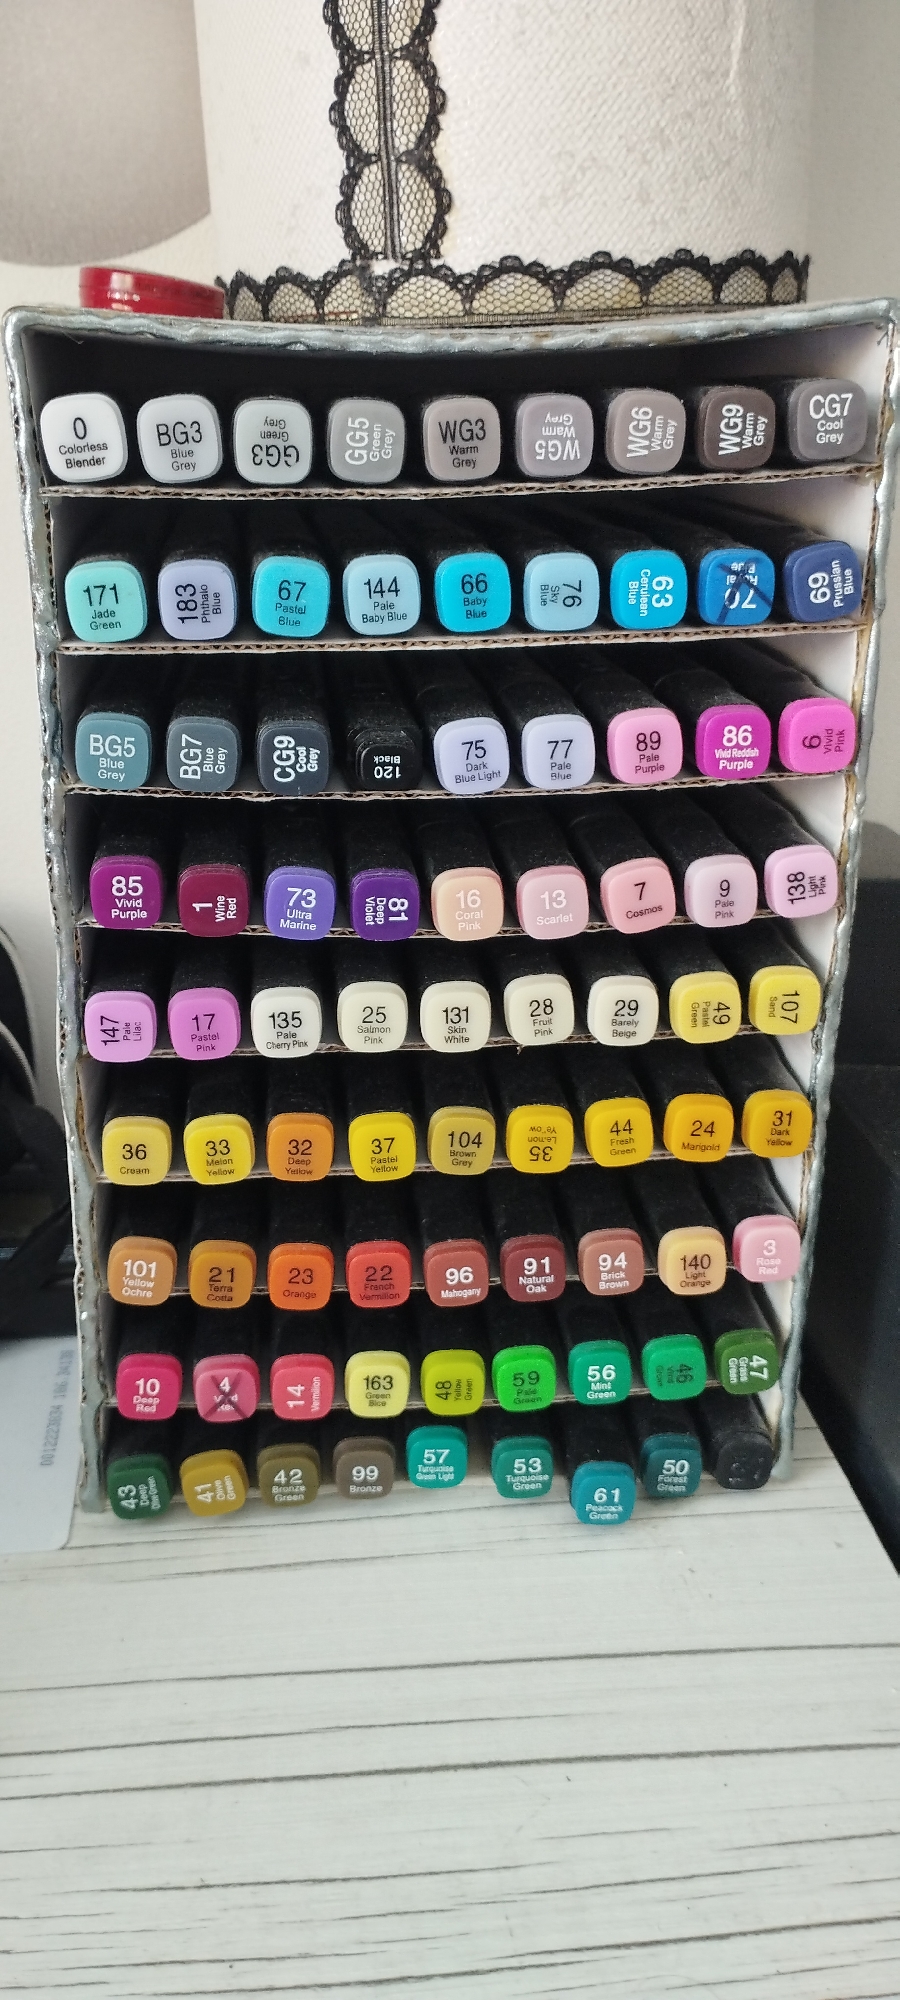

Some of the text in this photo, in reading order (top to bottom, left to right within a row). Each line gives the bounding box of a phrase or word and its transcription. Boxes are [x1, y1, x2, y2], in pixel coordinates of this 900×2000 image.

[809, 393, 853, 419] CG7
[264, 416, 286, 428] Grey
[545, 413, 573, 425] Grey
[817, 419, 843, 430] Cool
[73, 417, 87, 440] 0
[156, 421, 202, 446] BG3
[260, 432, 289, 441] Green
[438, 419, 486, 443] WG3
[542, 427, 576, 437] Warm
[627, 406, 652, 457] WG6
[651, 415, 664, 451] Warm
[663, 419, 677, 449] Grey
[718, 404, 744, 455] WG9
[345, 417, 369, 465] GG5
[370, 424, 381, 461] Green
[382, 429, 395, 458] Grey
[816, 432, 844, 444] Grey
[59, 442, 108, 455] Colorless
[171, 449, 194, 458] Blue
[252, 445, 300, 467] GG3
[449, 445, 478, 455] Warm
[535, 440, 580, 461] WG5
[65, 457, 106, 468] Blender
[172, 461, 196, 472] Grey
[452, 458, 476, 468] Grey
[364, 576, 400, 599] 144
[461, 573, 487, 595] 66
[808, 572, 831, 604] 69
[833, 560, 844, 608] Prussian
[844, 568, 852, 595] Blue
[82, 583, 119, 607] 171
[278, 579, 306, 602] 67
[563, 580, 582, 607] 76
[628, 581, 639, 605] Blue
[639, 569, 650, 617] Cerulean
[652, 576, 674, 608] 63
[175, 583, 199, 624] 183
[202, 584, 211, 623] Phthalo
[212, 592, 221, 615] Blue
[373, 601, 394, 611] Pale
[463, 597, 487, 607] Baby
[91, 609, 116, 619] Jade
[362, 611, 407, 624] Baby Blue
[465, 609, 487, 619] Blue
[90, 620, 121, 630] Green
[636, 731, 661, 751] 89
[722, 725, 752, 747] 86
[802, 734, 822, 750] 6
[89, 734, 135, 757] BG5
[462, 739, 486, 760] 75
[547, 739, 573, 759] 77
[714, 747, 759, 759] Vivid Reddish
[99, 758, 124, 769] Blue
[180, 733, 202, 780] BG7
[203, 748, 214, 772] Blue
[215, 747, 228, 774] Grey
[274, 735, 295, 782] CG9
[374, 755, 400, 764] Black
[374, 765, 401, 779] 120
[466, 761, 488, 772] Dark
[719, 760, 753, 771] Purple
[98, 770, 125, 782] Grey
[455, 770, 501, 784] Blue Light
[111, 876, 143, 896] 85
[634, 882, 646, 901] 7
[719, 879, 730, 897] 9
[787, 871, 805, 905] 138
[115, 898, 142, 908] Vivid
[287, 887, 316, 908] 73
[456, 890, 481, 909] 16
[541, 890, 567, 910] 13
[111, 909, 147, 920] Purple
[193, 902, 212, 912] 1
[215, 895, 226, 922] Wine
[226, 897, 236, 919] Red
[286, 909, 311, 920] Ultra
[365, 896, 375, 925] Violet
[376, 897, 386, 925] Deep
[388, 897, 408, 921] 81
[626, 904, 663, 919] Cosmos
[279, 918, 317, 931] Marine
[536, 913, 573, 925] Scarlet
[362, 1006, 386, 1023] 25
[442, 1006, 469, 1024] 131
[529, 998, 554, 1017] 28
[614, 999, 638, 1017] 29
[713, 1002, 731, 1025] 49
[781, 990, 800, 1024] 107
[192, 1013, 216, 1032] 17
[268, 1010, 302, 1030] 135
[101, 1015, 120, 1045] 147
[276, 1031, 297, 1040] Pale
[447, 1026, 466, 1034] Skin
[266, 1039, 308, 1051] Cherry Pink
[444, 1035, 470, 1044] White
[772, 1110, 792, 1127] 31
[609, 1119, 633, 1136] 44
[690, 1120, 715, 1137] 24
[206, 1139, 230, 1157] 33
[288, 1139, 312, 1156] 32
[371, 1137, 395, 1154] 37
[448, 1131, 482, 1149] 104
[122, 1144, 147, 1160] 36
[371, 1155, 397, 1165] Pastel
[450, 1150, 476, 1158] Brown
[529, 1145, 552, 1162] 35
[371, 1164, 398, 1173] Yellow
[452, 1159, 472, 1168] Grey
[763, 1239, 775, 1256] 3
[124, 1259, 157, 1278] 101
[524, 1256, 551, 1275] 91
[598, 1252, 627, 1271] 94
[680, 1254, 711, 1271] 140
[209, 1266, 236, 1282] 21
[288, 1268, 314, 1285] 23
[365, 1265, 393, 1281] 22
[445, 1267, 473, 1285] 96
[519, 1275, 554, 1285] Natural
[601, 1271, 625, 1280] Brick
[441, 1287, 481, 1299] Mahogany
[526, 1284, 546, 1293] Oak
[599, 1279, 629, 1290] Brown
[587, 1365, 616, 1382] 56
[676, 1364, 694, 1383] 46
[750, 1355, 769, 1381] 47
[135, 1378, 160, 1397] 10
[220, 1377, 231, 1392] 4
[364, 1375, 394, 1391] 163
[513, 1371, 540, 1388] 59
[591, 1382, 611, 1390] Mint
[286, 1384, 305, 1408] 14
[311, 1376, 321, 1411] Vermilion
[435, 1381, 452, 1400] 48
[587, 1390, 616, 1399] Green
[423, 1449, 450, 1464] 57
[352, 1466, 378, 1481] 99
[513, 1458, 542, 1474] 53
[662, 1460, 690, 1475] 50
[274, 1469, 304, 1484] 42
[505, 1474, 549, 1482] Turquoise
[195, 1483, 212, 1503] 41
[513, 1482, 542, 1490] Green
[118, 1485, 138, 1510] 43
[594, 1488, 621, 1503] 61
